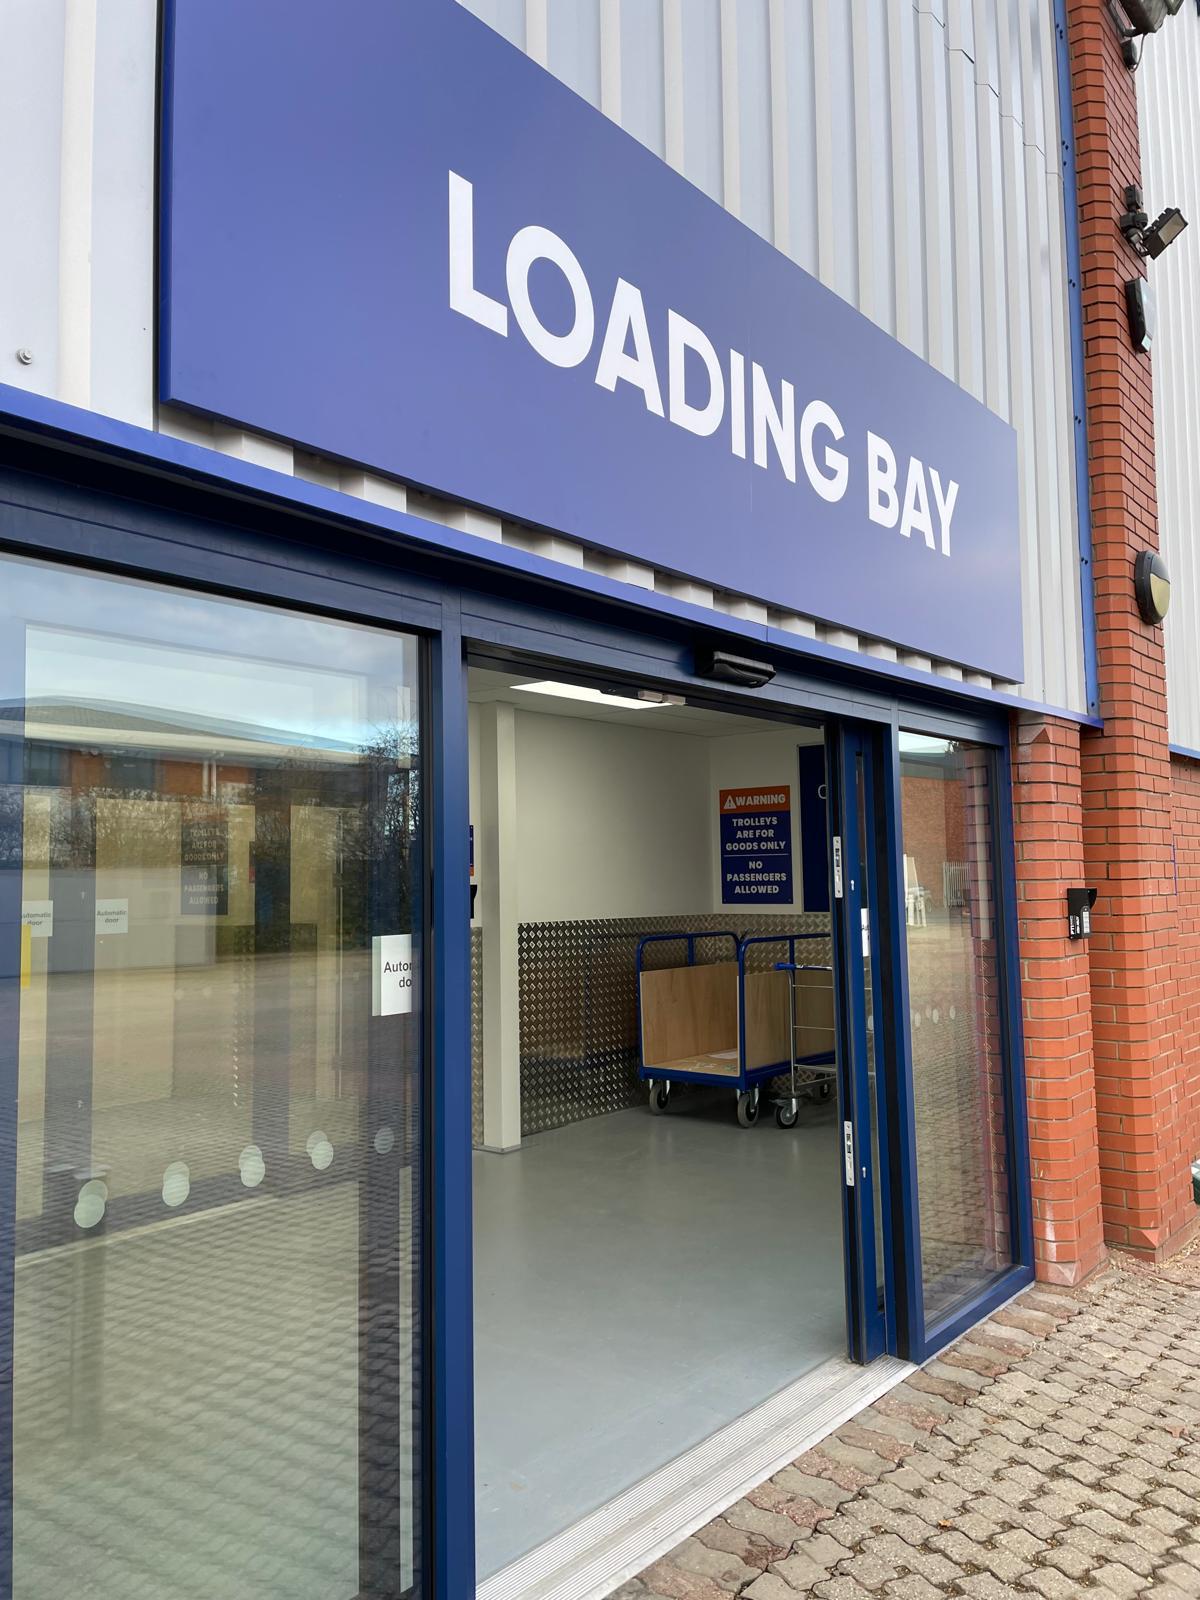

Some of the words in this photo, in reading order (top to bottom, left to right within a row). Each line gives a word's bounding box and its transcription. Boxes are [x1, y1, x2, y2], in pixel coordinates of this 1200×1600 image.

[448, 169, 850, 503] LOADING
[866, 430, 960, 558] BAY
[735, 794, 786, 806] WARNING
[732, 816, 778, 827] TROLLEYS
[736, 830, 754, 839] ARE
[755, 829, 775, 838] FOR
[725, 842, 759, 851] GOODS
[760, 841, 786, 850] ONLY
[748, 861, 763, 870] NO
[726, 872, 787, 882] PASSENGERS
[734, 885, 780, 894] ALLOWED
